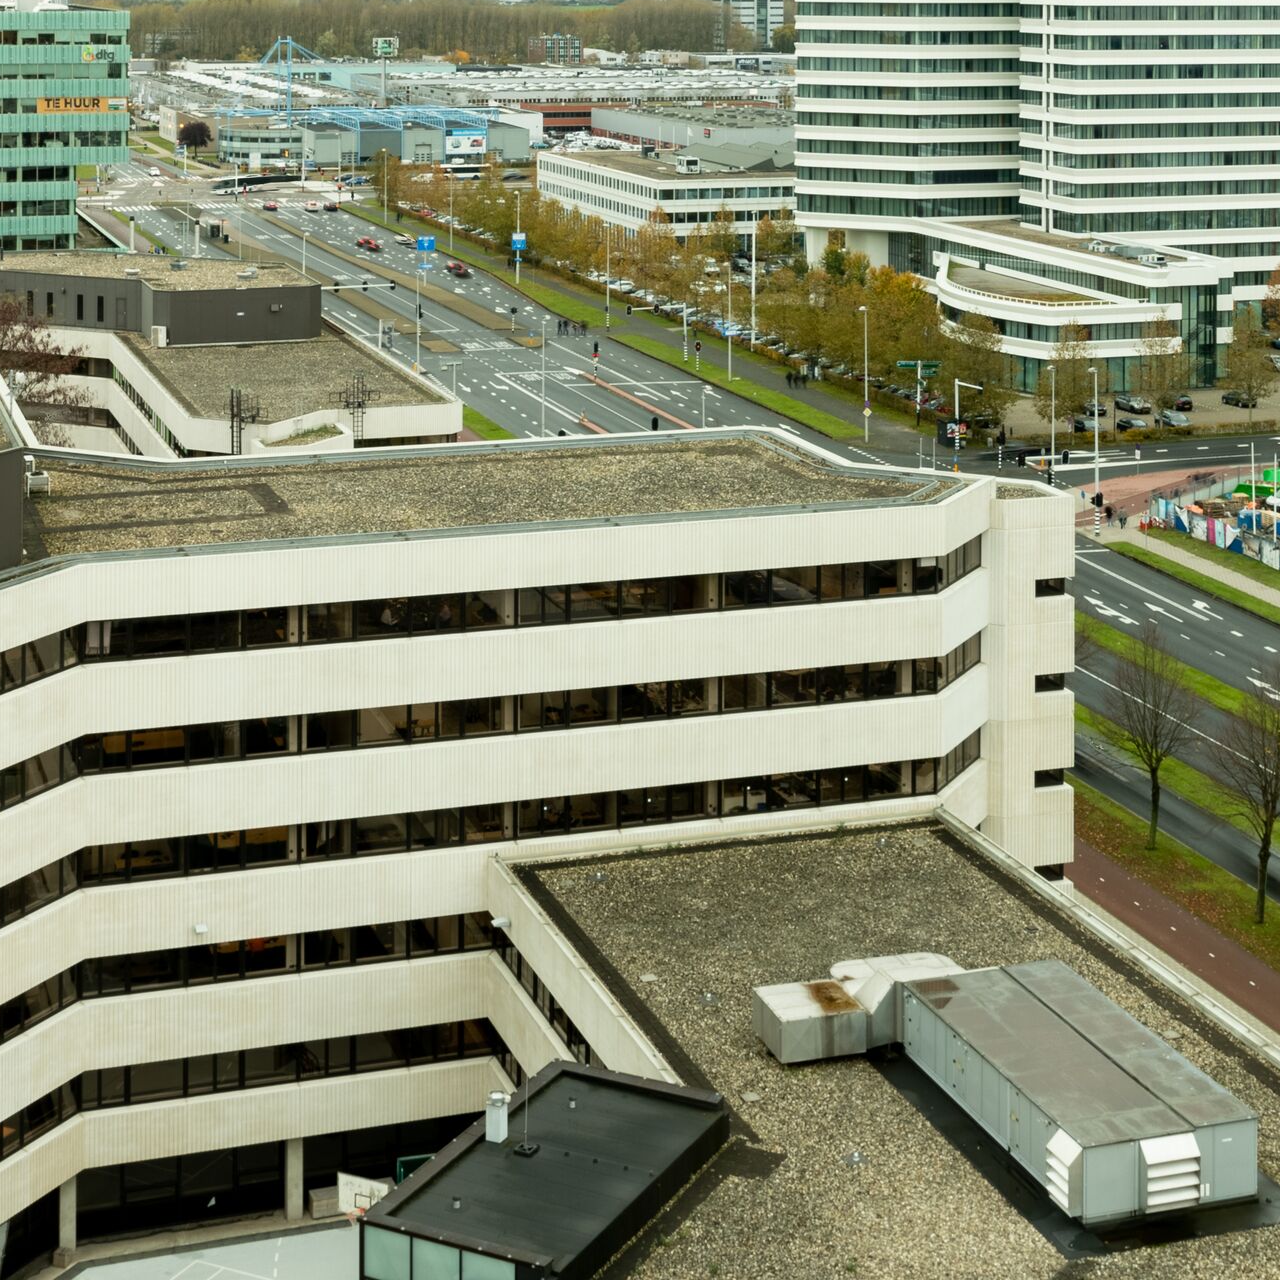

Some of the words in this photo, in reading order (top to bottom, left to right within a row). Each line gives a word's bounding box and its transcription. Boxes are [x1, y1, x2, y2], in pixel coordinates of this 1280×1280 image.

[96, 49, 115, 62] dtg
[44, 99, 60, 108] TE
[64, 98, 100, 108] HUUR
